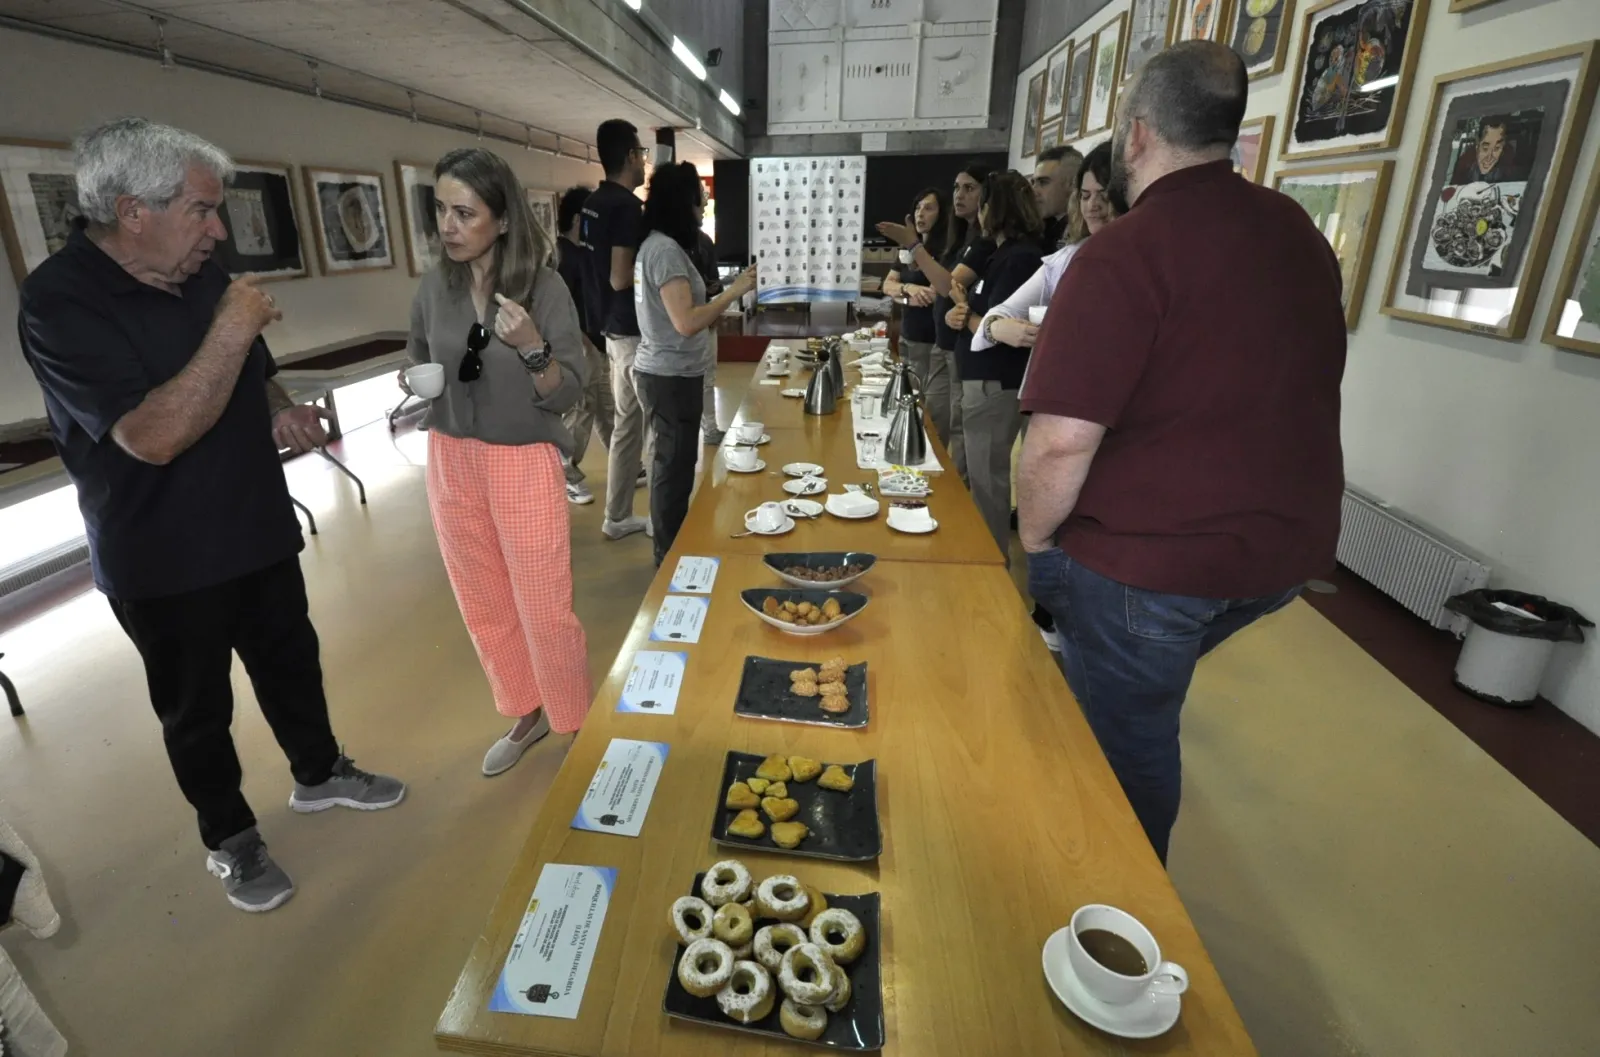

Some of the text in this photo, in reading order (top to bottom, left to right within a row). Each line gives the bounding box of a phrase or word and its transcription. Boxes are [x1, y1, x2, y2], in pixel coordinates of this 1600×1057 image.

[564, 884, 602, 996] ROSQUILLAS DE SANTA HILDEGARDA
